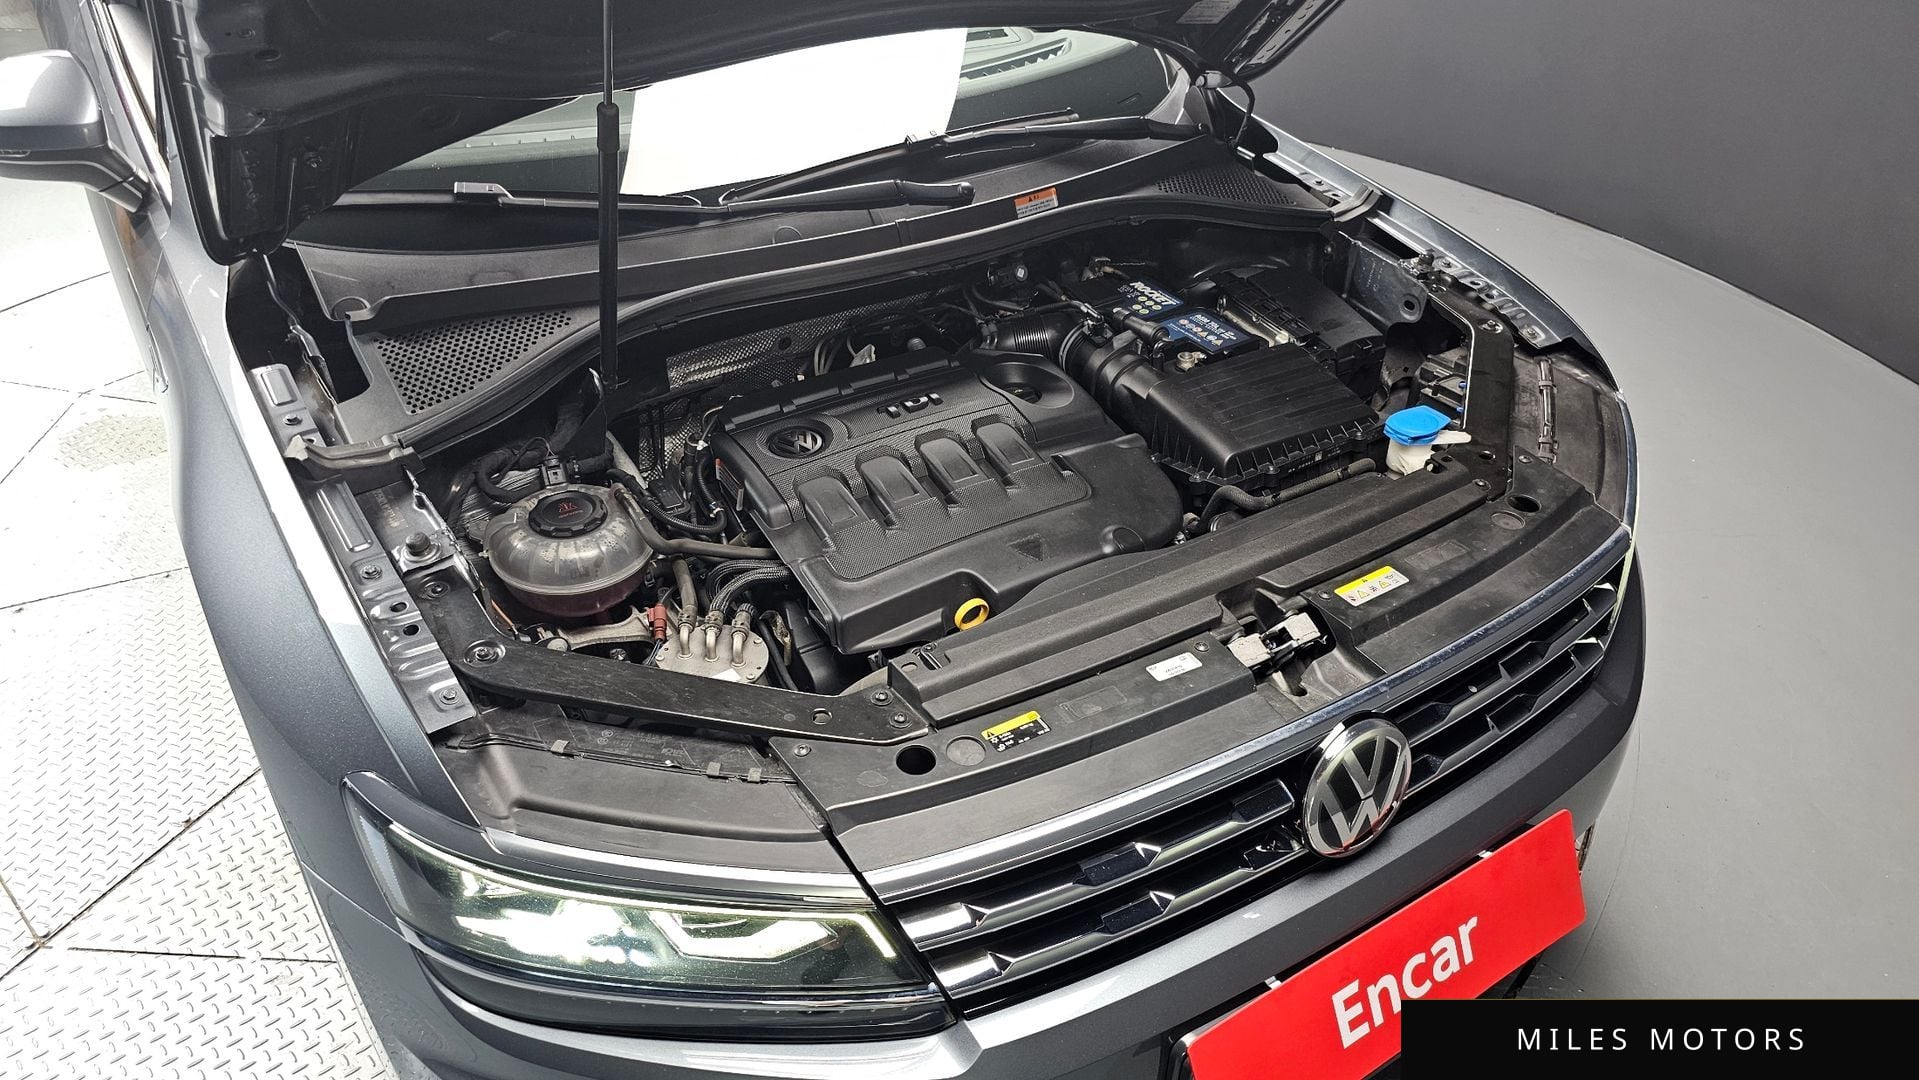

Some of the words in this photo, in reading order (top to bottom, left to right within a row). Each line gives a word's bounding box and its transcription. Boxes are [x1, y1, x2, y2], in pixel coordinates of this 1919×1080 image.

[1129, 281, 1177, 305] ROCKET
[876, 392, 943, 419] TDI
[1331, 916, 1478, 1050] Encar
